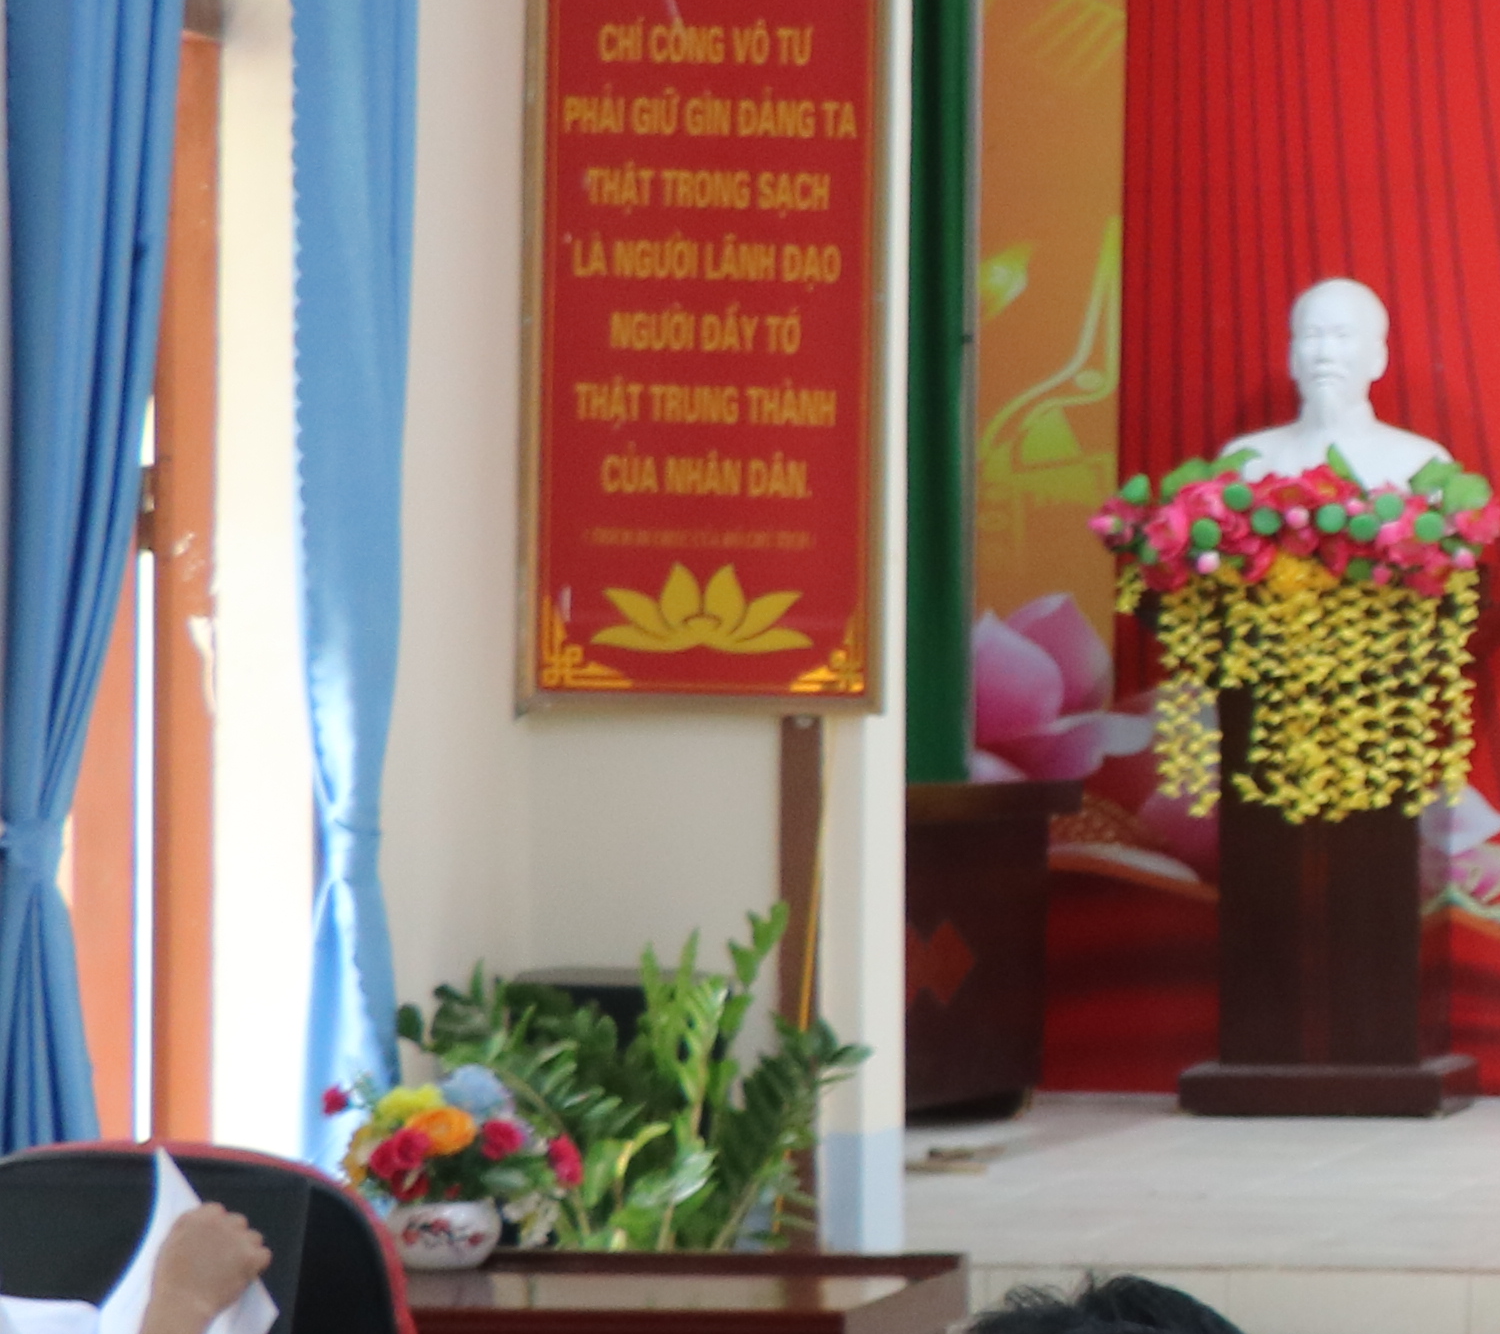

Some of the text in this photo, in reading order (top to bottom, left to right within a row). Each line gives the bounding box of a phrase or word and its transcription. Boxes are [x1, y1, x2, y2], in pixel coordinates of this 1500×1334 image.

[598, 17, 814, 66] CHÍ CÔNG VÔ TƯ
[563, 83, 858, 139] PHẢI GIỮ GÌN ĐẢNG TA
[586, 160, 831, 218] THẬT TRONG SẠCH
[572, 231, 842, 292] LÀ NGƯỜI LÃNH ĐẠO
[574, 373, 837, 430] THẬT TRUNG THÀNH
[600, 441, 658, 493] CỦA
[664, 447, 741, 496] NHÂN
